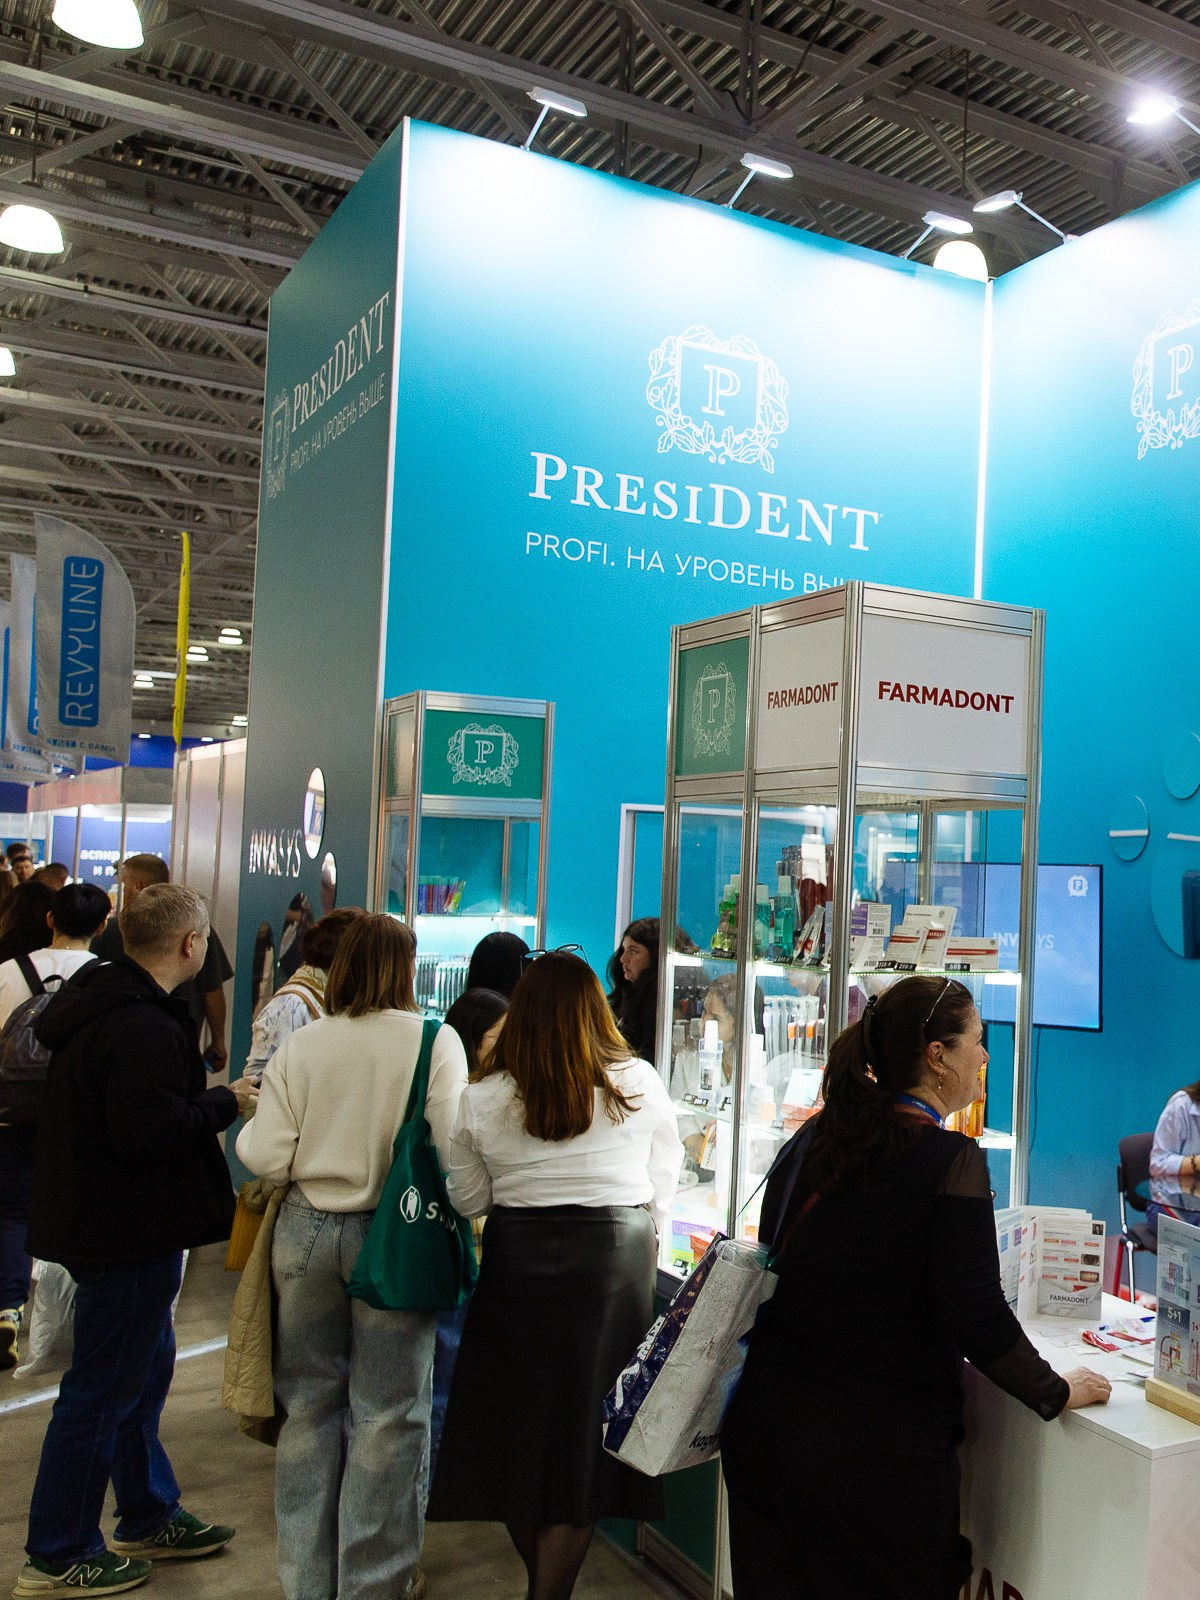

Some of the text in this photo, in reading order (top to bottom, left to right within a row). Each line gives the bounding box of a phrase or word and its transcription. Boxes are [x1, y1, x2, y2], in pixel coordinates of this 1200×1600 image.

[291, 290, 390, 433] PRESIDENT
[323, 398, 357, 448] УРОВЕНЬ
[359, 373, 385, 418] ВЫШЕ
[527, 451, 879, 551] PRESIDENT
[525, 531, 845, 593] PROFI. НА УРОВЕНЬ ВЫ
[65, 561, 99, 721] REVYLINE
[767, 681, 839, 710] FARMADONT
[877, 680, 1015, 714] FARMADONT
[249, 828, 301, 878] INVASYS
[993, 931, 1055, 950] INVYS
[1049, 1294, 1089, 1304] FARMADONT
[1168, 1307, 1182, 1323] 5+1
